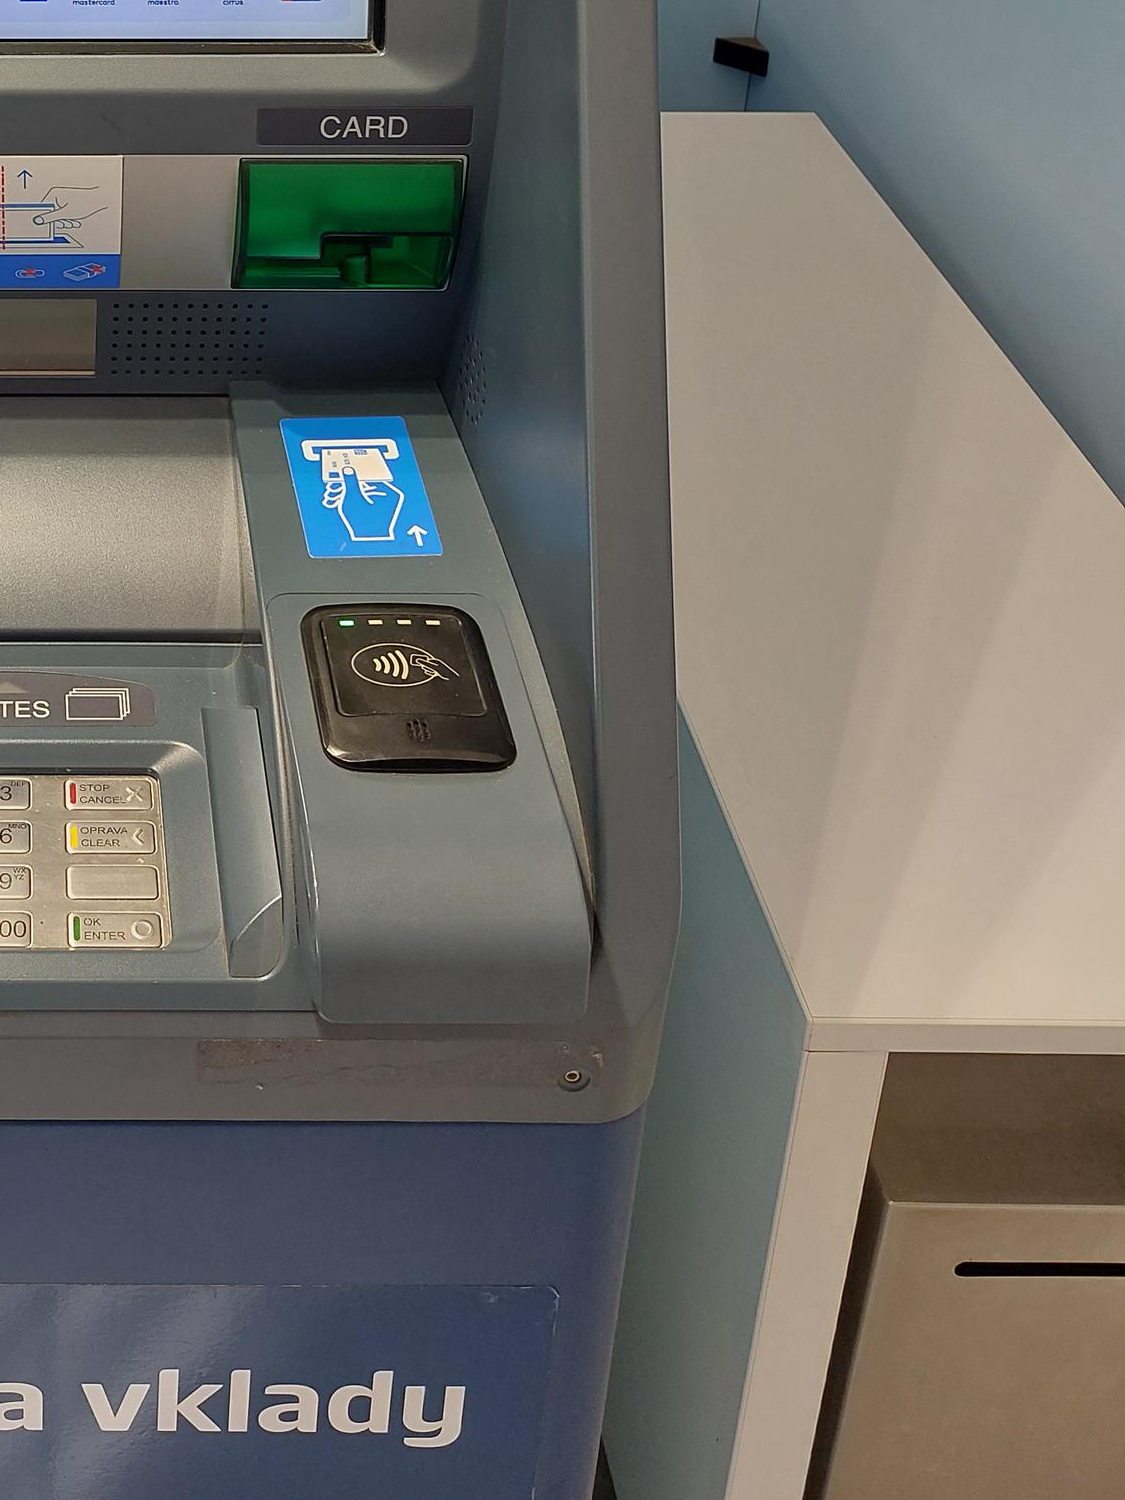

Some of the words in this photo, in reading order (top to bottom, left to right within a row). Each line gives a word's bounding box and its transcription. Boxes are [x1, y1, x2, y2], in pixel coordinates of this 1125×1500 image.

[319, 116, 409, 140] CARD
[79, 784, 110, 792] STOP
[0, 786, 13, 801] 3
[79, 796, 126, 804] CANCEL
[80, 826, 128, 835] OPRAVA
[0, 828, 13, 844] 6
[81, 838, 120, 847] CLEAR
[0, 872, 13, 890] 9
[83, 918, 101, 926] OK
[84, 932, 126, 940] ENTER
[80, 1368, 467, 1449] vklady
